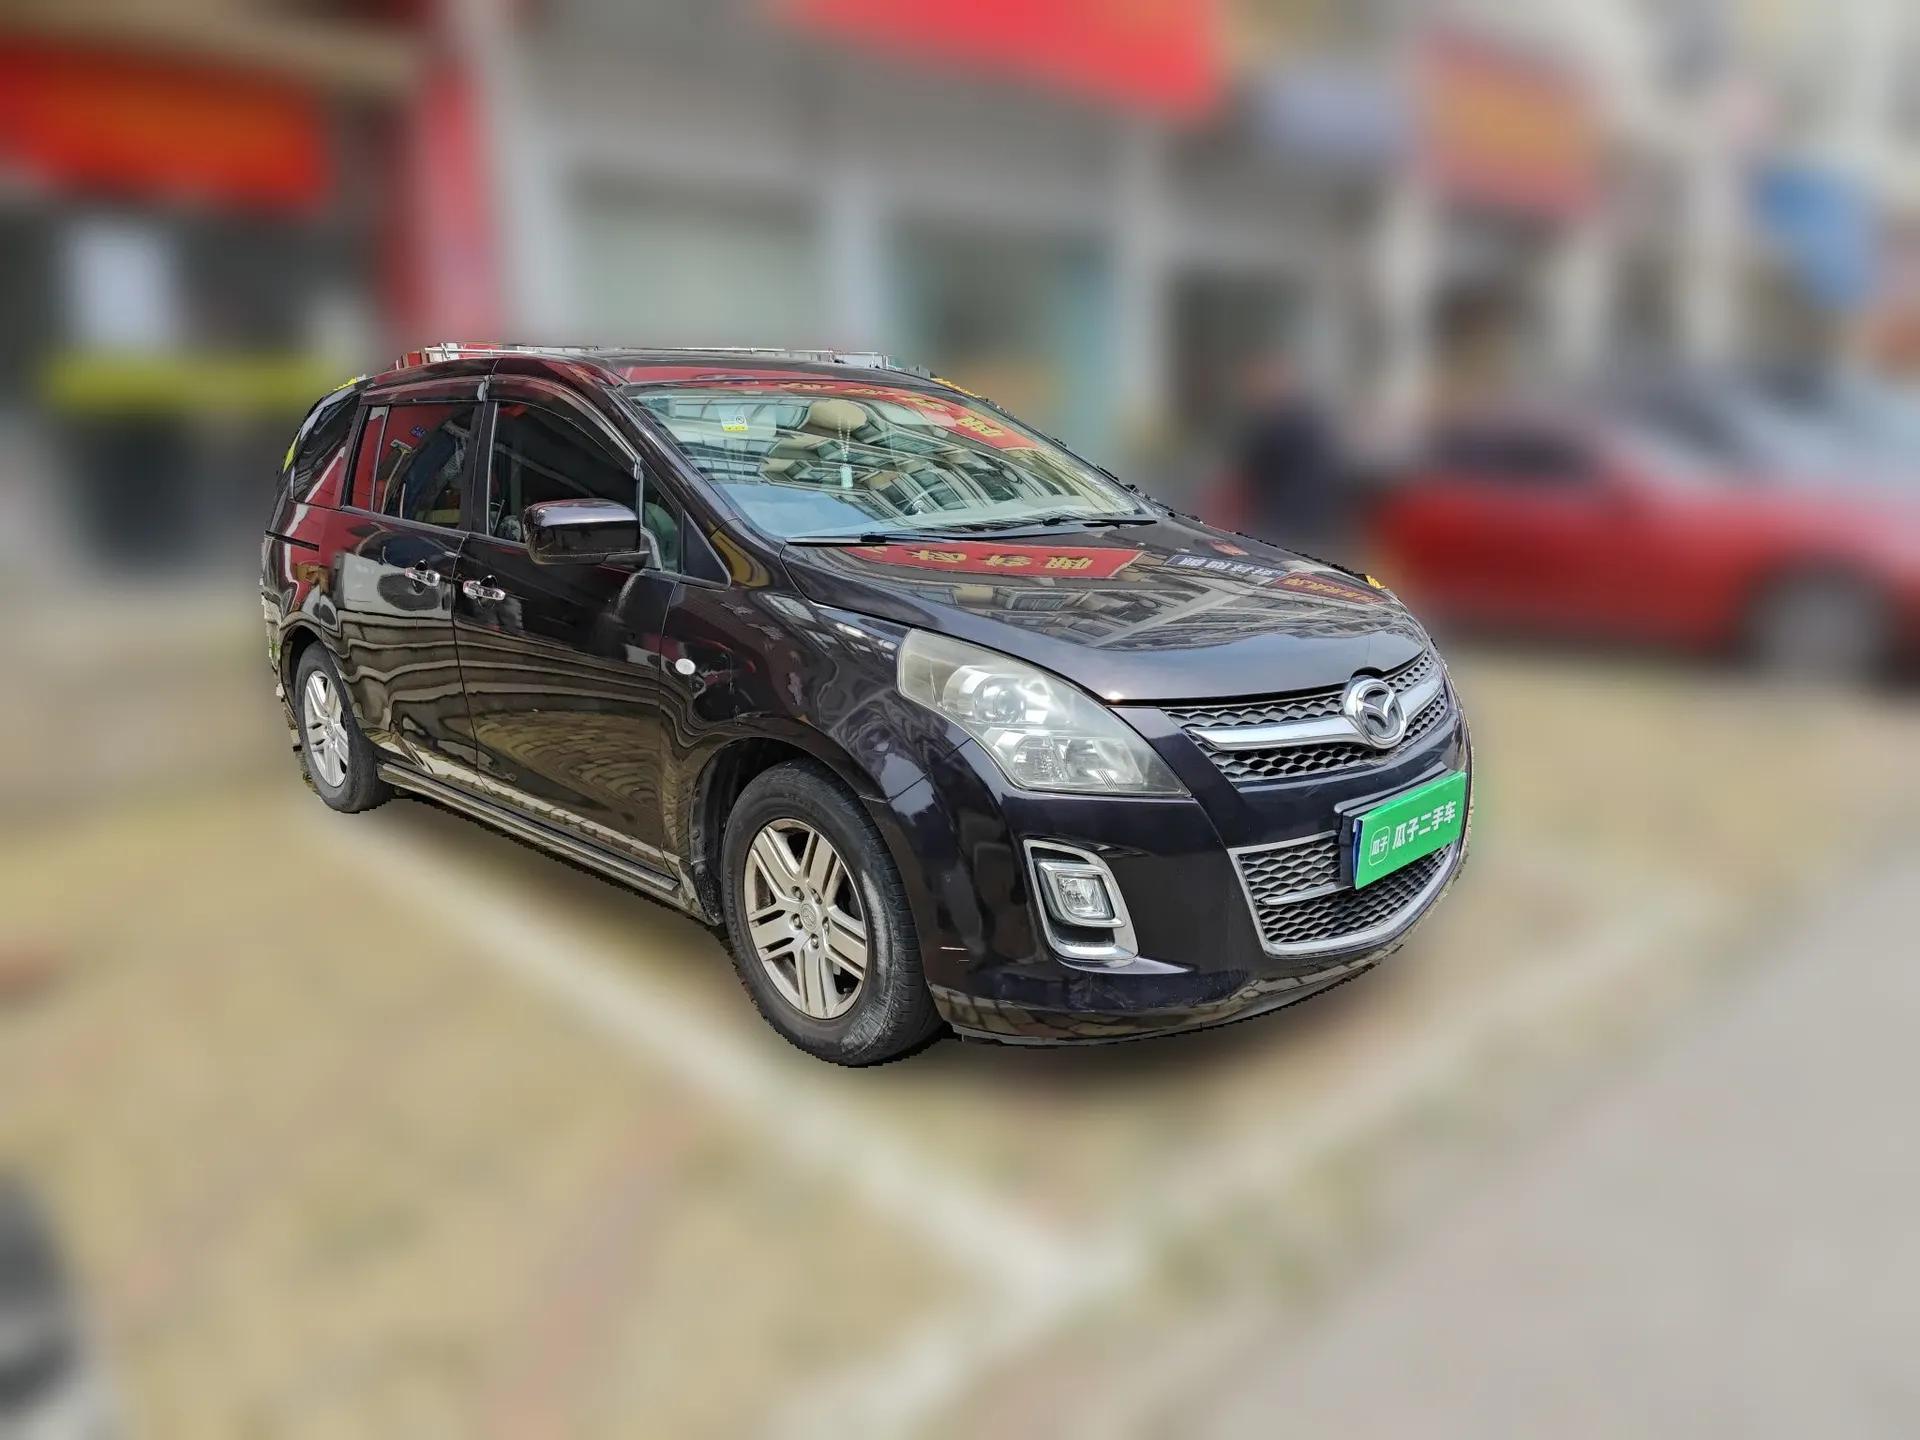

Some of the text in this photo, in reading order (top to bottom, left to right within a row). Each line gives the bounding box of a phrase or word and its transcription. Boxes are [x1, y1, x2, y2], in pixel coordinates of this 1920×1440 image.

[1392, 800, 1457, 850] 瓜子二手车
